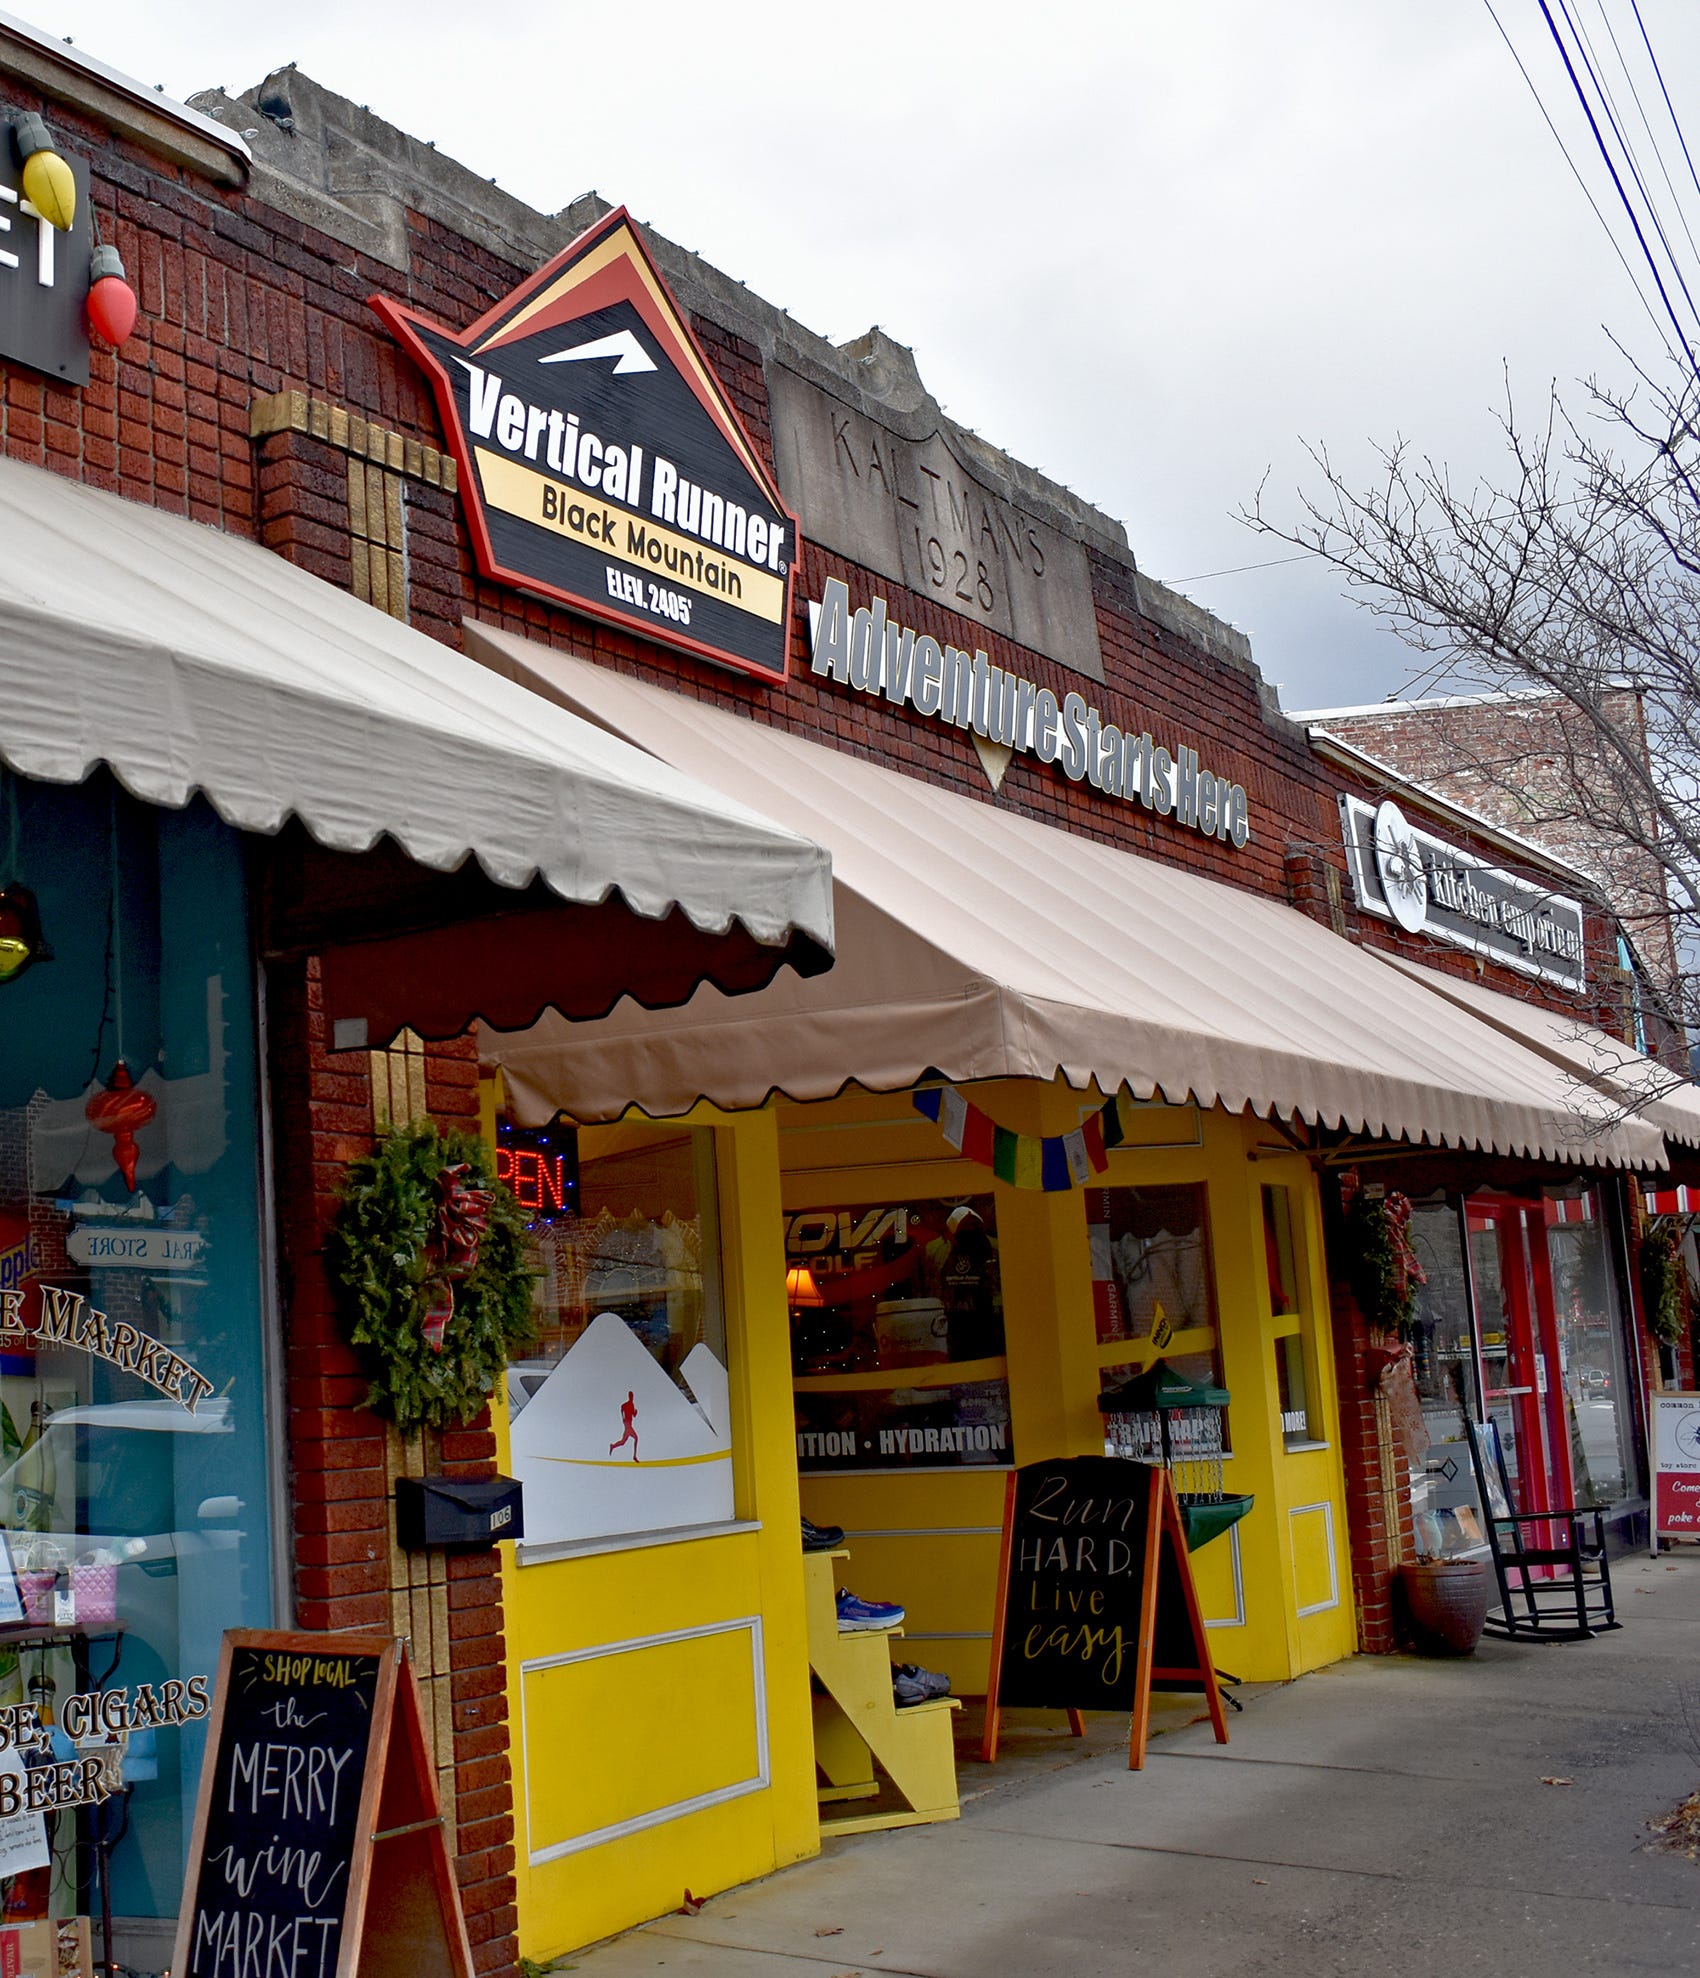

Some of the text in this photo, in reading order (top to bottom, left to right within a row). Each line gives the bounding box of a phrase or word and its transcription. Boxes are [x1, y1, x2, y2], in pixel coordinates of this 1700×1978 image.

[450, 355, 785, 571] Vertical Runner
[829, 412, 1047, 577] KALTMAN'S
[542, 484, 742, 599] Black Mountain
[914, 526, 995, 612] 1928
[606, 566, 692, 625] ELEV. 2405'
[811, 576, 1248, 848] Adventure Starts Here
[1106, 1284, 1119, 1334] GARMIN
[32, 1284, 214, 1416] MARKET
[880, 1424, 1006, 1454] HYDRATION
[1661, 1462, 1673, 1470] toy
[492, 1507, 510, 1527] 106
[1029, 1476, 1135, 1532] Run
[1667, 1511, 1693, 1526] poke
[1020, 1537, 1132, 1577] HARD,
[1031, 1580, 1104, 1615] Live
[263, 1655, 313, 1687] SHOP
[61, 1676, 210, 1743] CIGARS
[261, 1697, 328, 1728] the
[0, 1757, 111, 1820] BEER
[228, 1742, 353, 1826] MERRY
[208, 1834, 345, 1909] wine
[193, 1909, 339, 1978] MARKET
